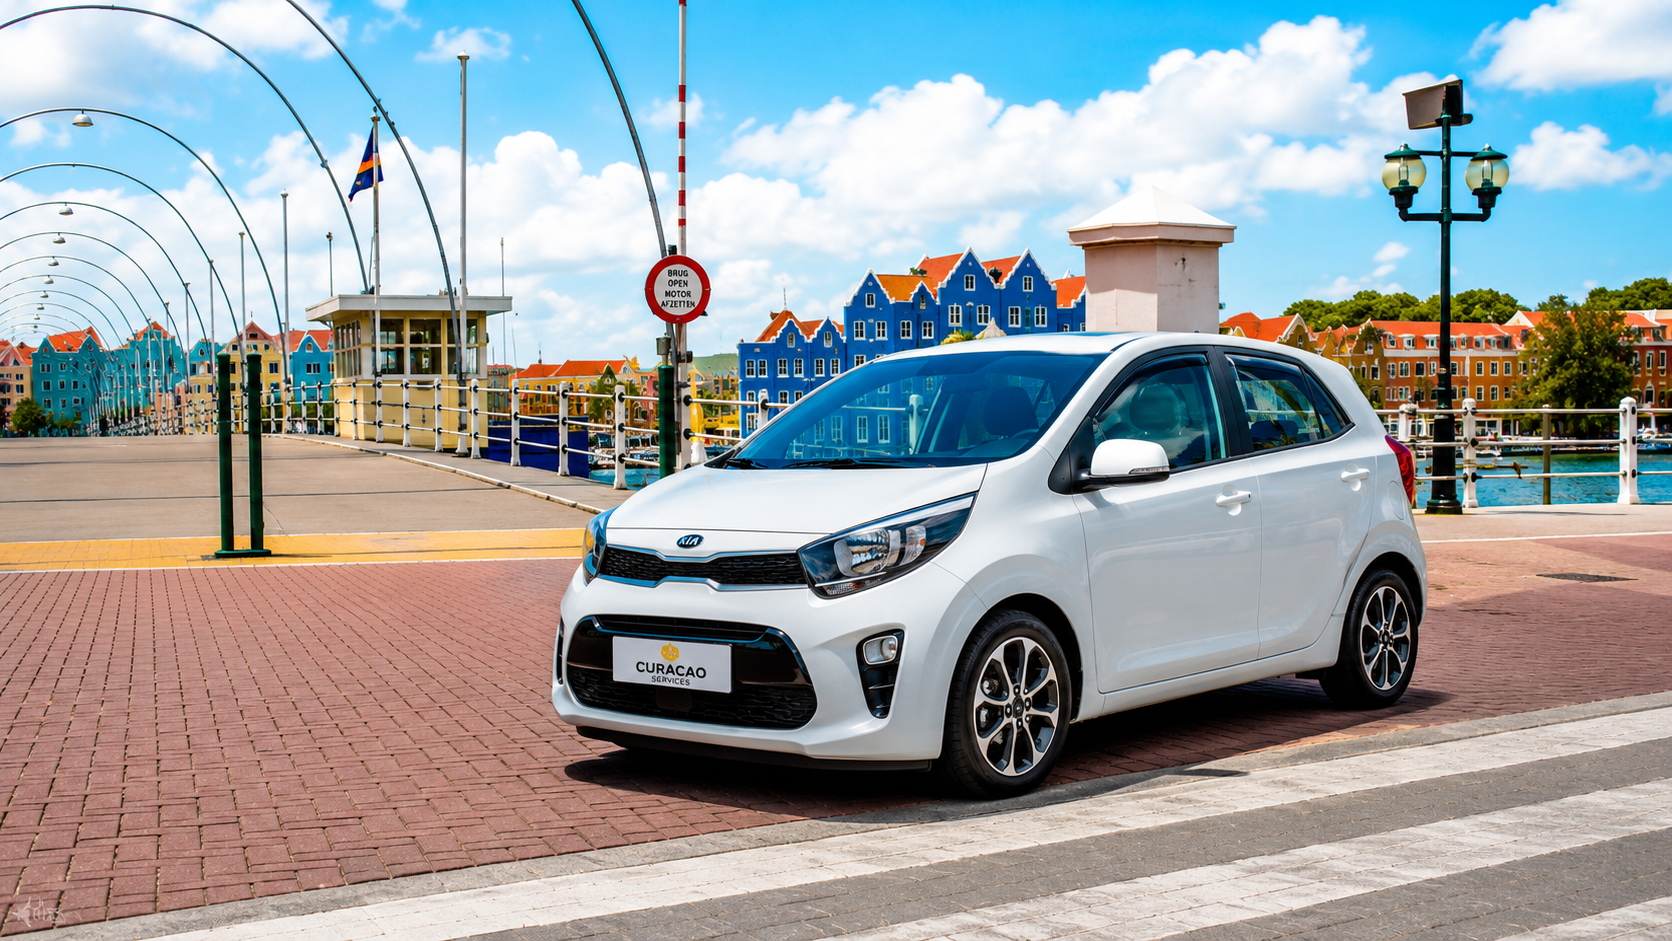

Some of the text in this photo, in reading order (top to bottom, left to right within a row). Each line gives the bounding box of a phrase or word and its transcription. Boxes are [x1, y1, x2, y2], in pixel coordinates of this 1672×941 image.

[667, 269, 689, 278] BRUG
[667, 279, 689, 288] OPEN
[664, 290, 692, 298] MOTOR
[678, 536, 699, 546] KIA
[635, 661, 707, 679] CURACAO
[651, 675, 691, 686] SERVICES
